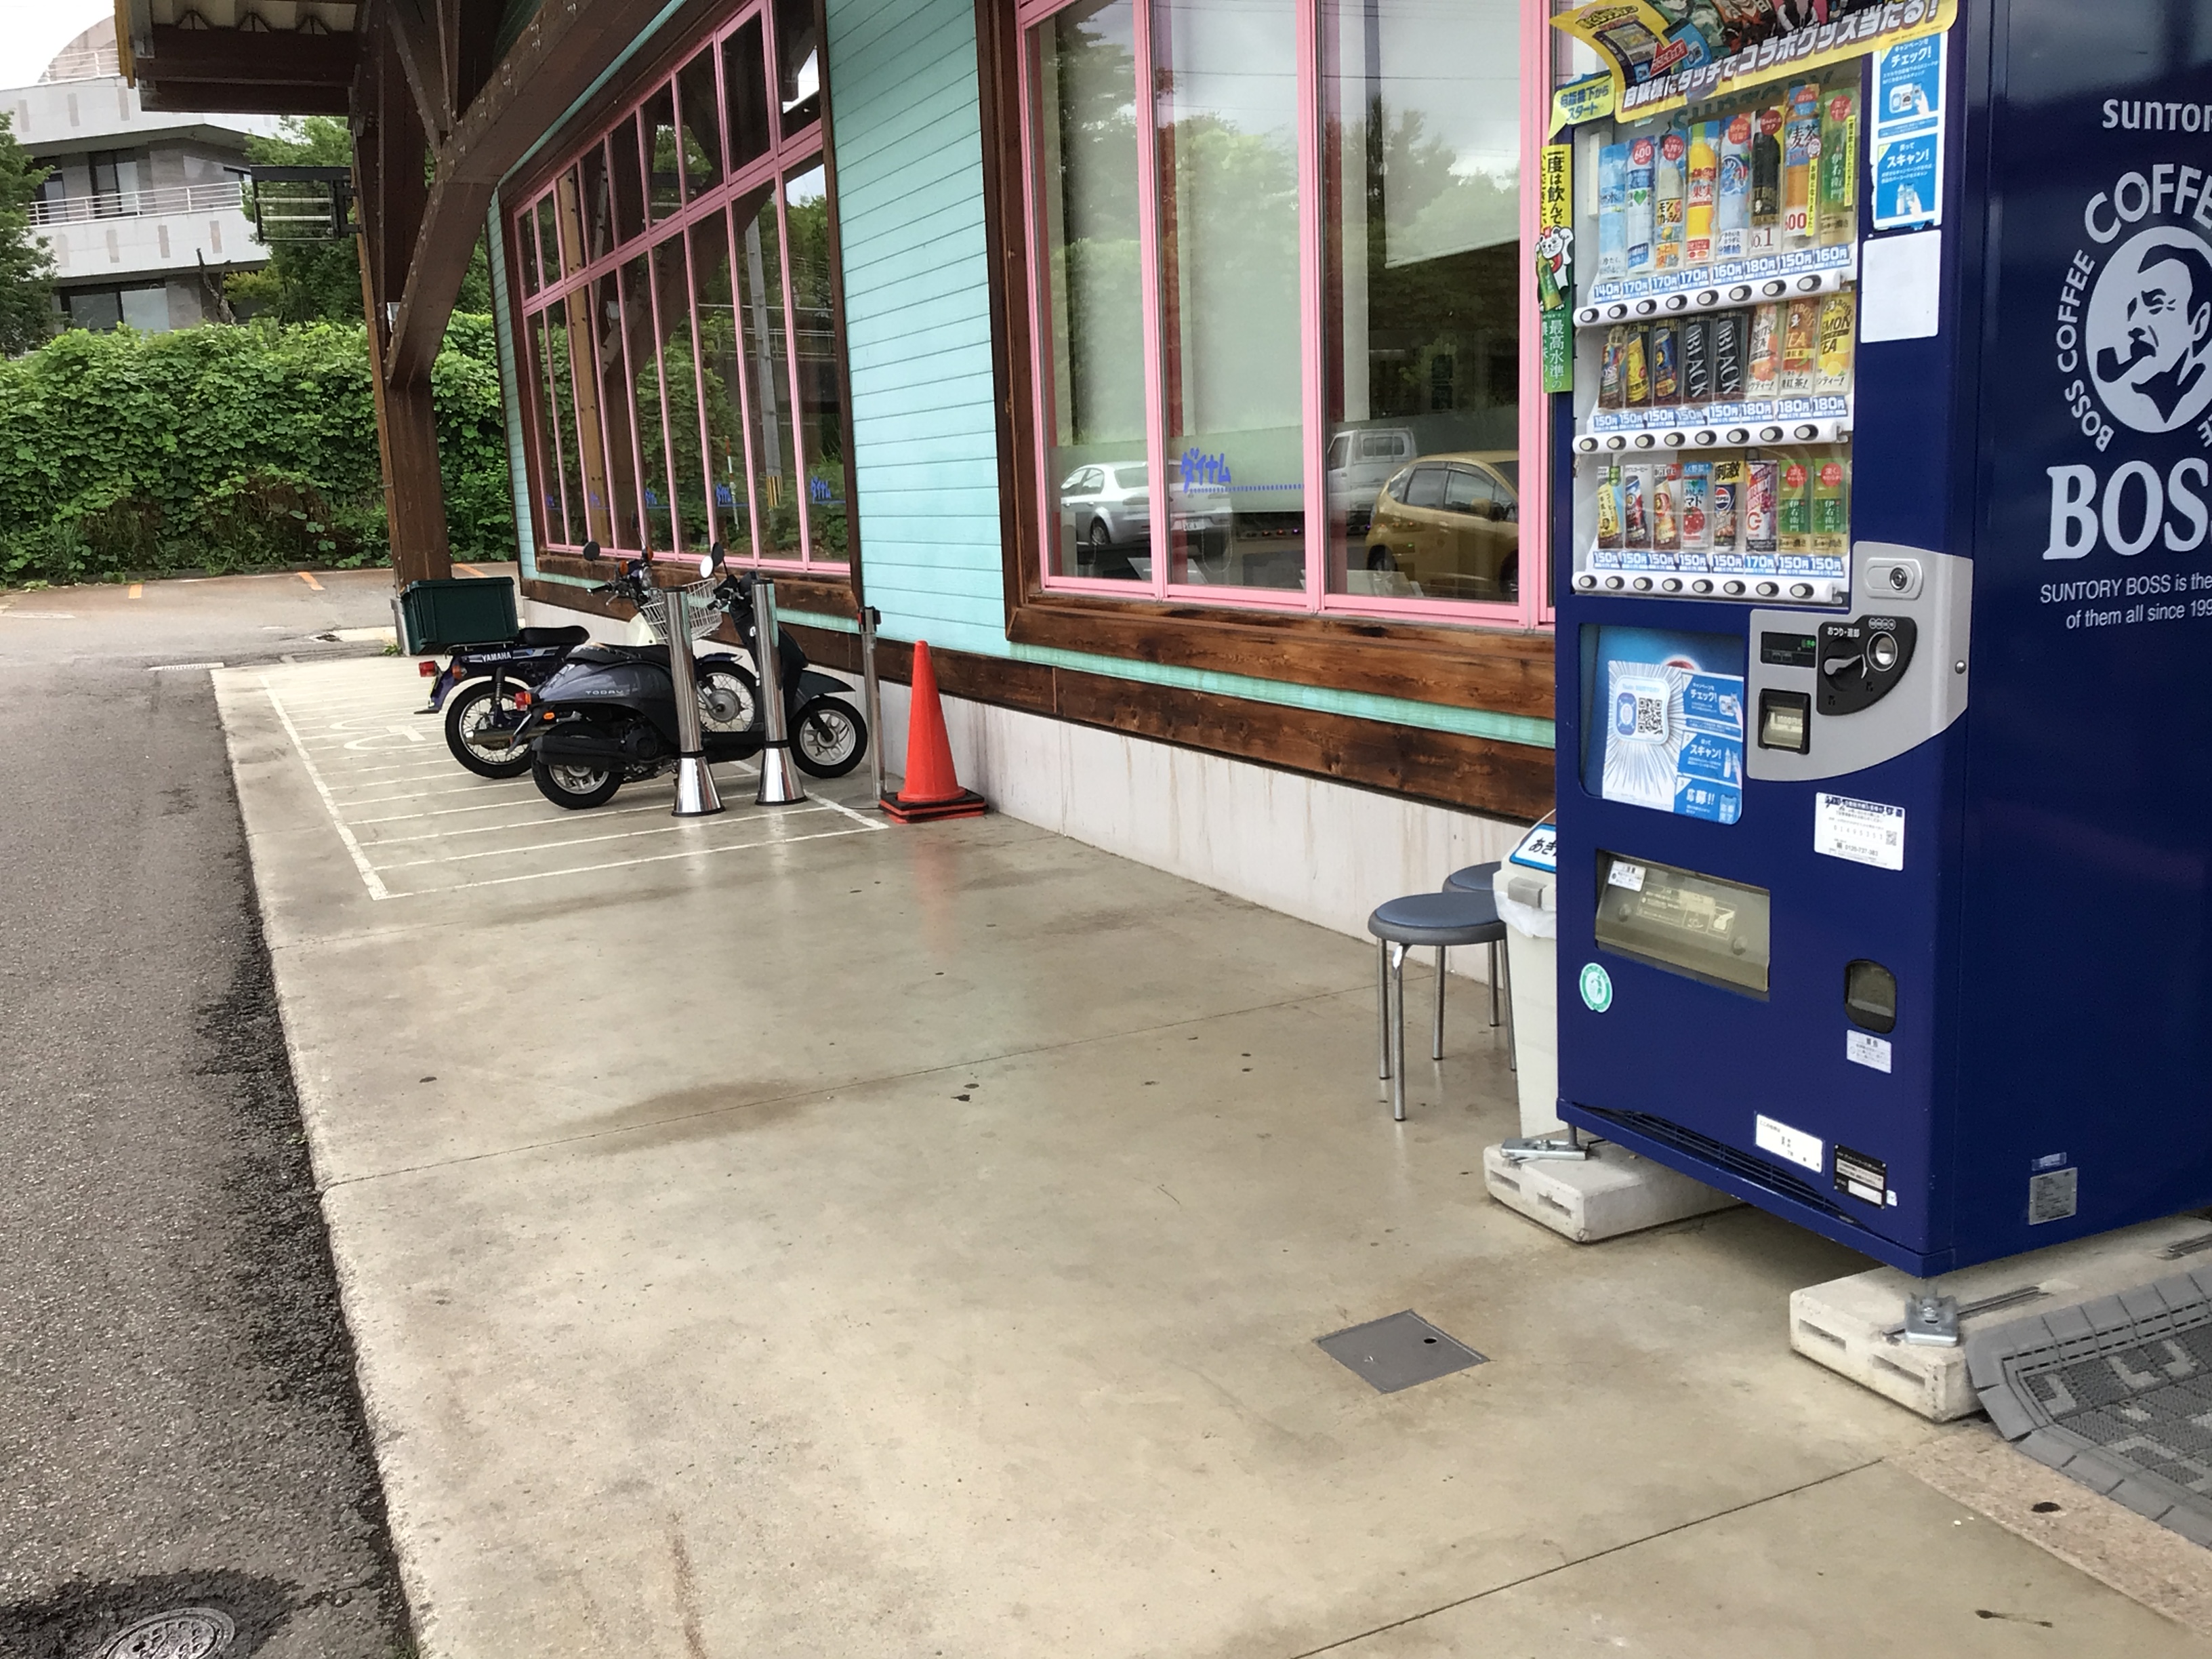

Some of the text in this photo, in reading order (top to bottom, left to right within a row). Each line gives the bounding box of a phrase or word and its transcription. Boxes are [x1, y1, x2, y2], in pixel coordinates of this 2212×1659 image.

[1891, 45, 1931, 68] チェック!
[1566, 102, 1599, 121] スタート
[1791, 124, 1818, 150] 麦茶
[1634, 145, 1652, 161] 600
[1887, 148, 1929, 169] スキャン!
[1547, 151, 1565, 224] 一度は飲んで
[1781, 252, 1812, 268] 150円
[1816, 247, 1847, 263] 160円
[1714, 263, 1742, 278] 160円
[1745, 258, 1776, 273] 180円
[1653, 277, 1677, 290] 170円
[1681, 270, 1707, 283] 170円
[1595, 285, 1620, 299] 140円
[1623, 281, 1648, 295] 170円
[1822, 316, 1851, 333] EMON
[1787, 332, 1806, 348] TEA
[1549, 319, 1564, 389] 最高水準の
[2055, 249, 2114, 452] BOSS COFFEE
[1686, 329, 1709, 398] BLACK
[1717, 328, 1741, 395] BLACK
[1710, 405, 1738, 417] 150円
[1742, 403, 1771, 415] 180円
[1779, 399, 1809, 413] 180円
[1814, 397, 1845, 411] 180円
[1595, 415, 1617, 426] 150円
[1620, 413, 1643, 424] 150円
[1649, 409, 1673, 422] 150円
[1679, 410, 1703, 421] 150円
[1685, 496, 1702, 507] マト
[2043, 457, 2212, 560] BOS
[1595, 552, 1618, 564] 150円
[1622, 553, 1647, 565] 150円
[1649, 554, 1674, 565] 150円
[1680, 554, 1706, 566] 150円
[1714, 555, 1742, 567] 150円
[1746, 556, 1775, 568] 170円
[1780, 556, 1809, 569] 150円
[1811, 557, 1842, 570] 150円
[2040, 571, 2212, 604] SUNTORY BOSS is the
[2066, 609, 2083, 630] of
[2085, 608, 2121, 628] them
[2126, 604, 2144, 623] all
[2147, 603, 2186, 622] since
[481, 651, 512, 663] YAMAHA
[1690, 689, 1718, 703] チェック!
[1689, 744, 1721, 760] スキャン!
[1528, 838, 1557, 857] あき
